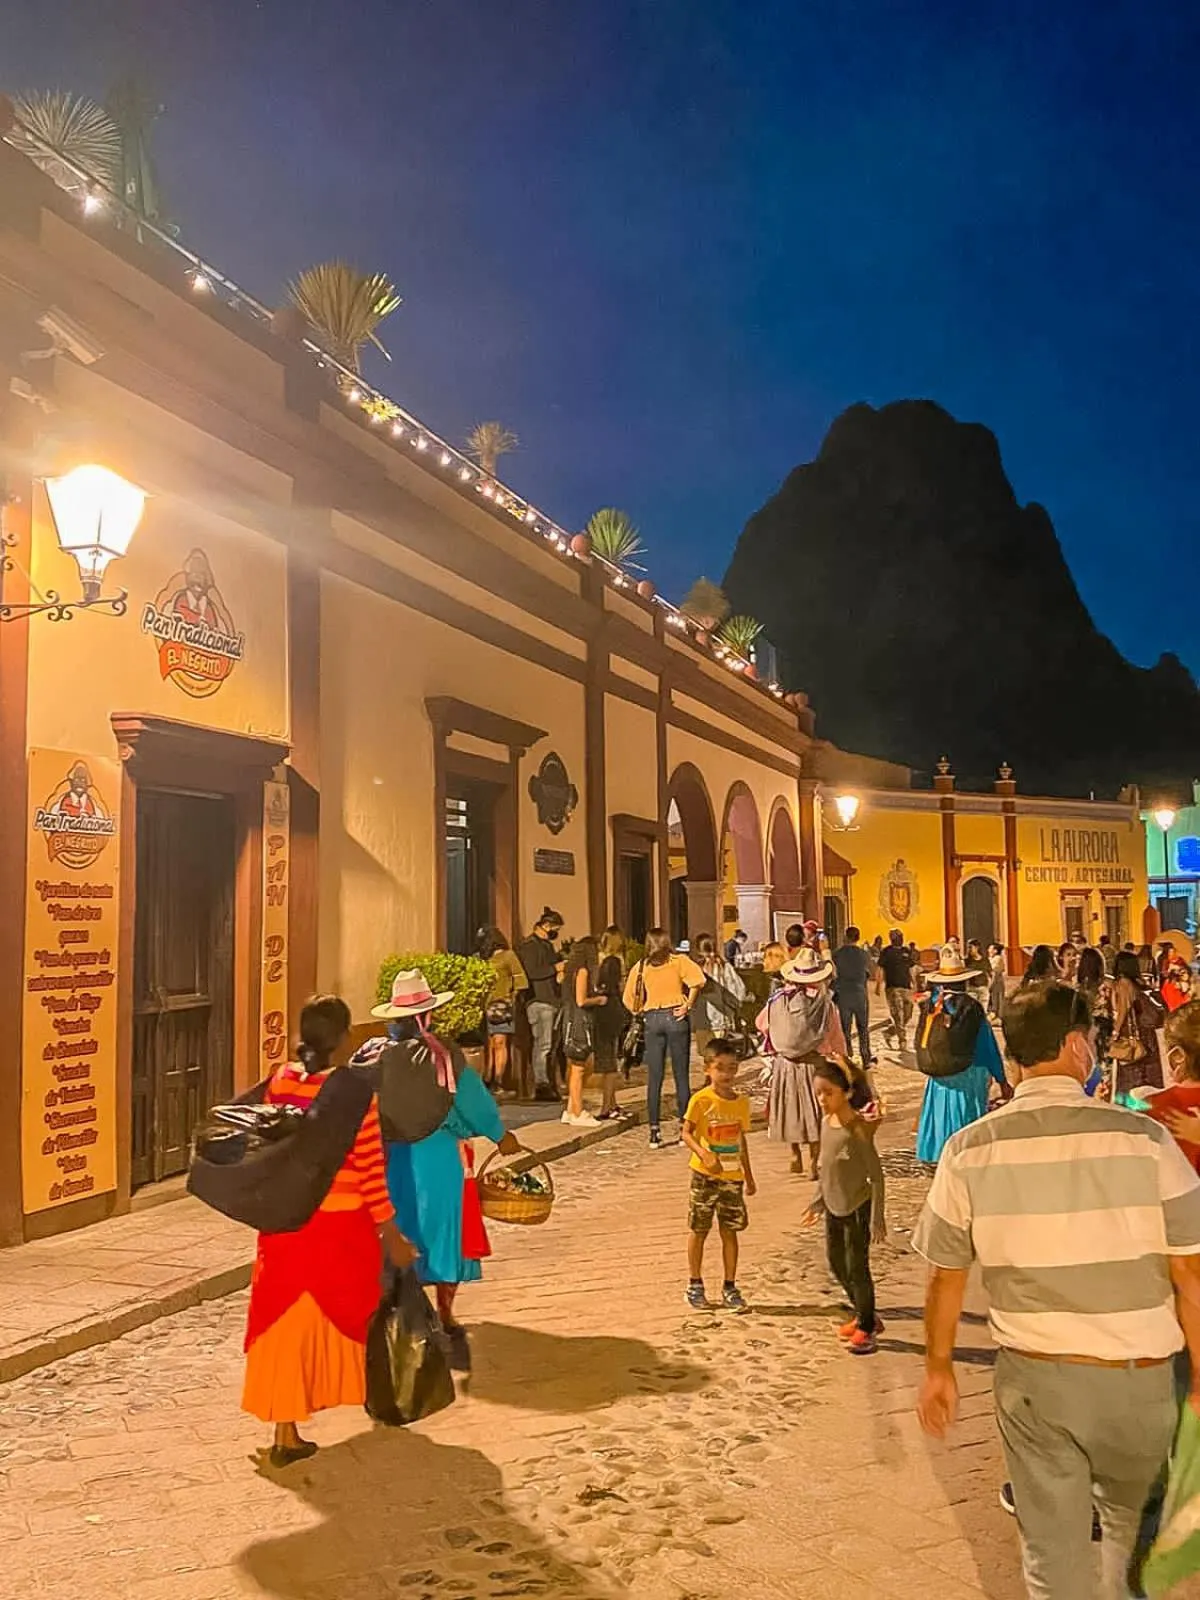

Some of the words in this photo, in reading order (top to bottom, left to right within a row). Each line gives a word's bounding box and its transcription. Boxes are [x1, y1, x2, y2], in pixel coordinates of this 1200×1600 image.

[142, 606, 172, 637] Pan
[172, 614, 243, 659] Tradicional
[34, 809, 57, 829] Pan
[1063, 829, 1120, 863] AURORA
[1025, 867, 1068, 882] CENTRO
[1074, 868, 1134, 883] ARTESANAL
